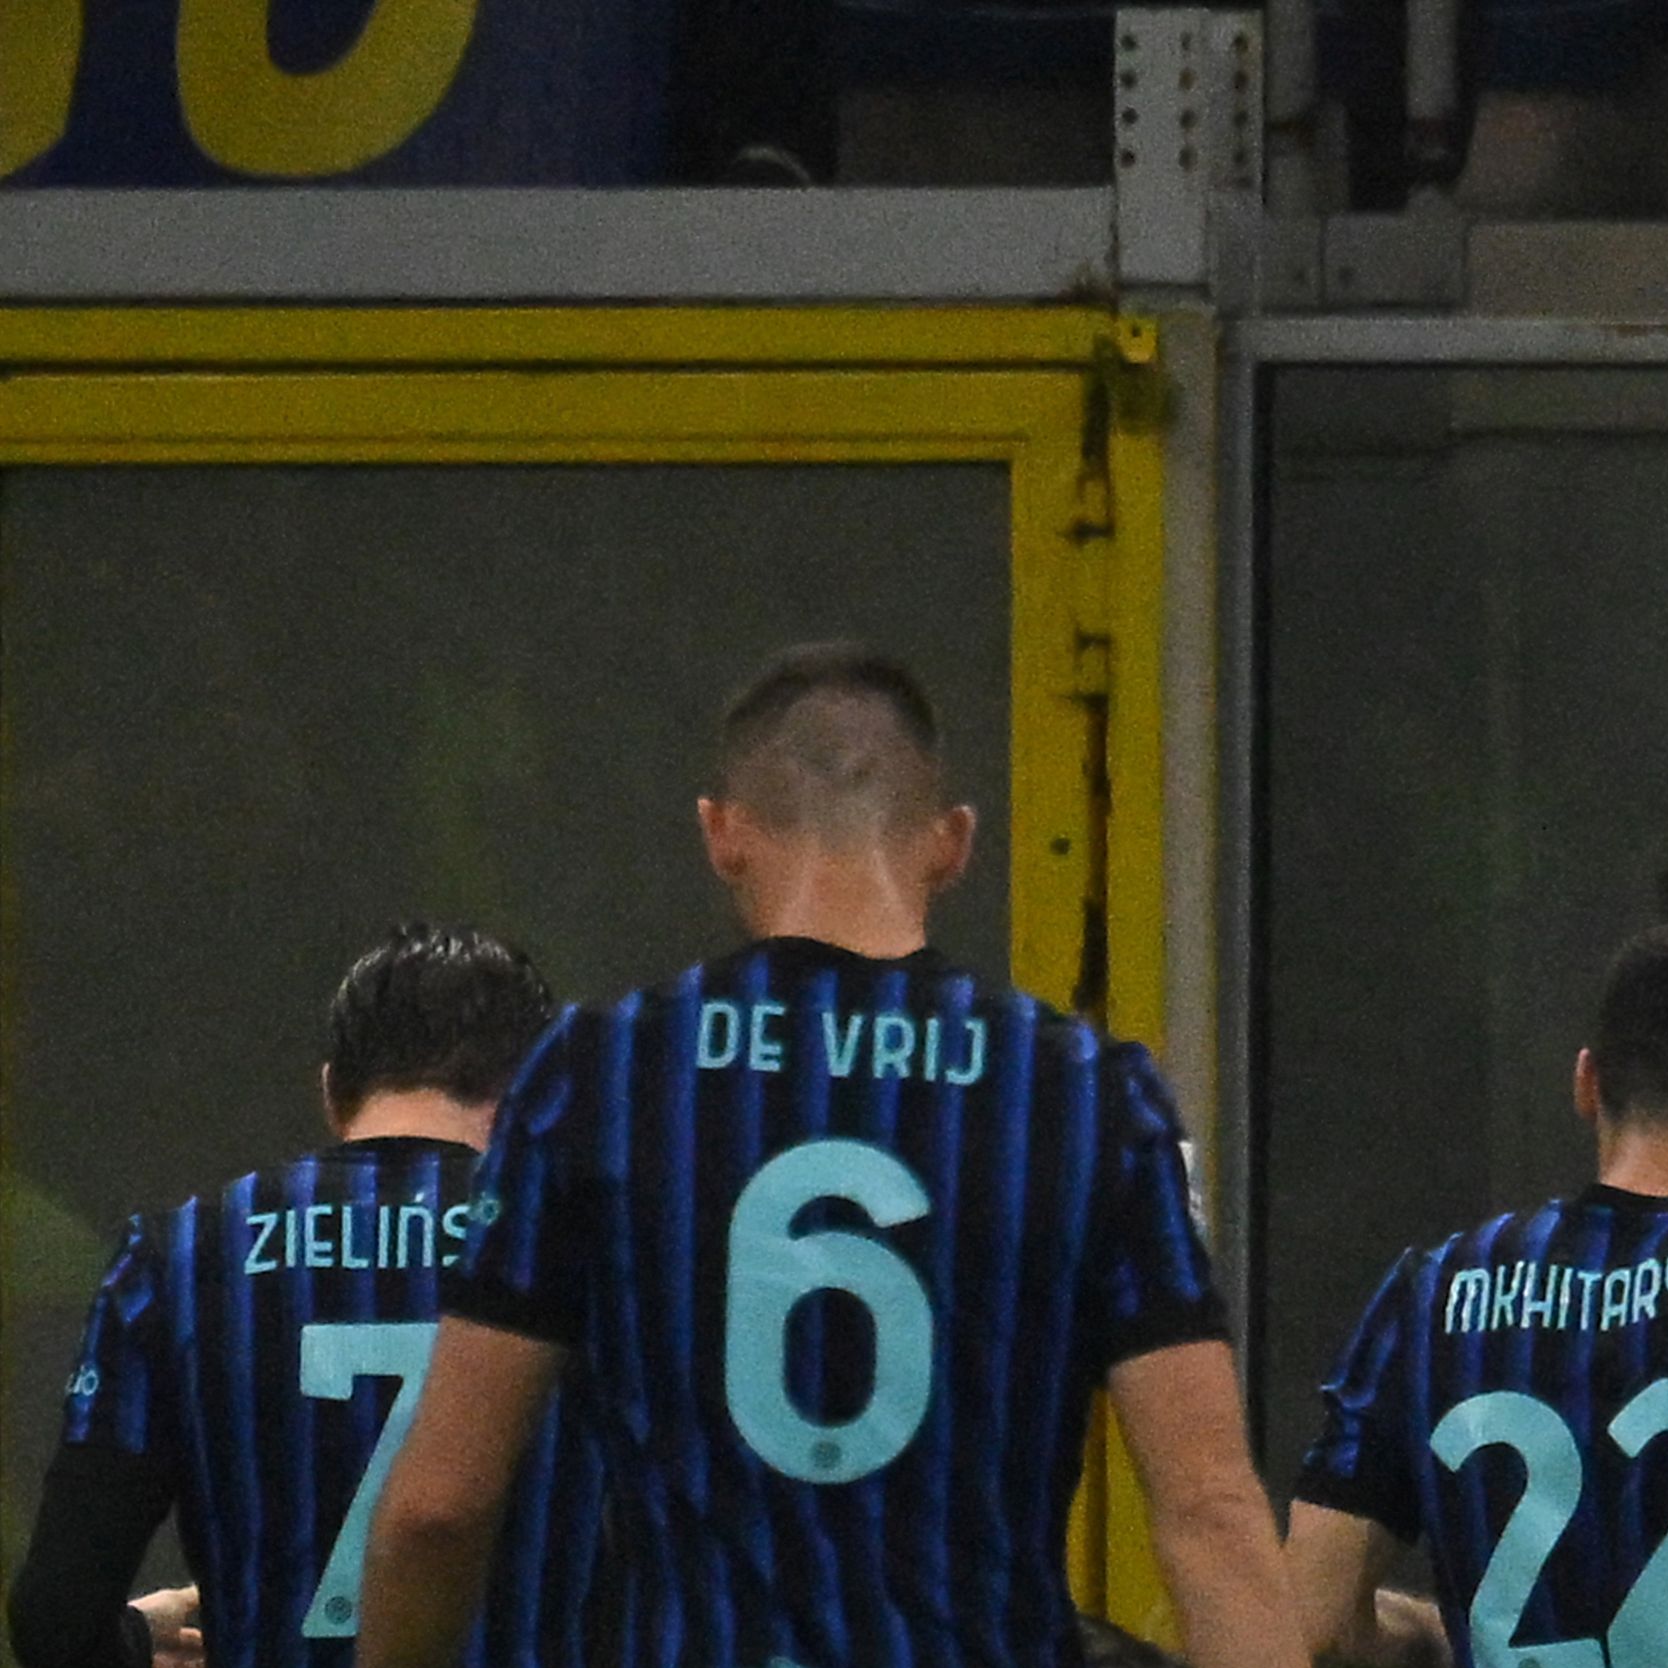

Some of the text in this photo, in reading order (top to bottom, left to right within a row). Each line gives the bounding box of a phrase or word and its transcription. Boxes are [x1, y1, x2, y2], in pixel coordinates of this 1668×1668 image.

[696, 1000, 989, 1087] DE VRIJ
[725, 1136, 933, 1485] 6
[299, 1322, 441, 1640] 7
